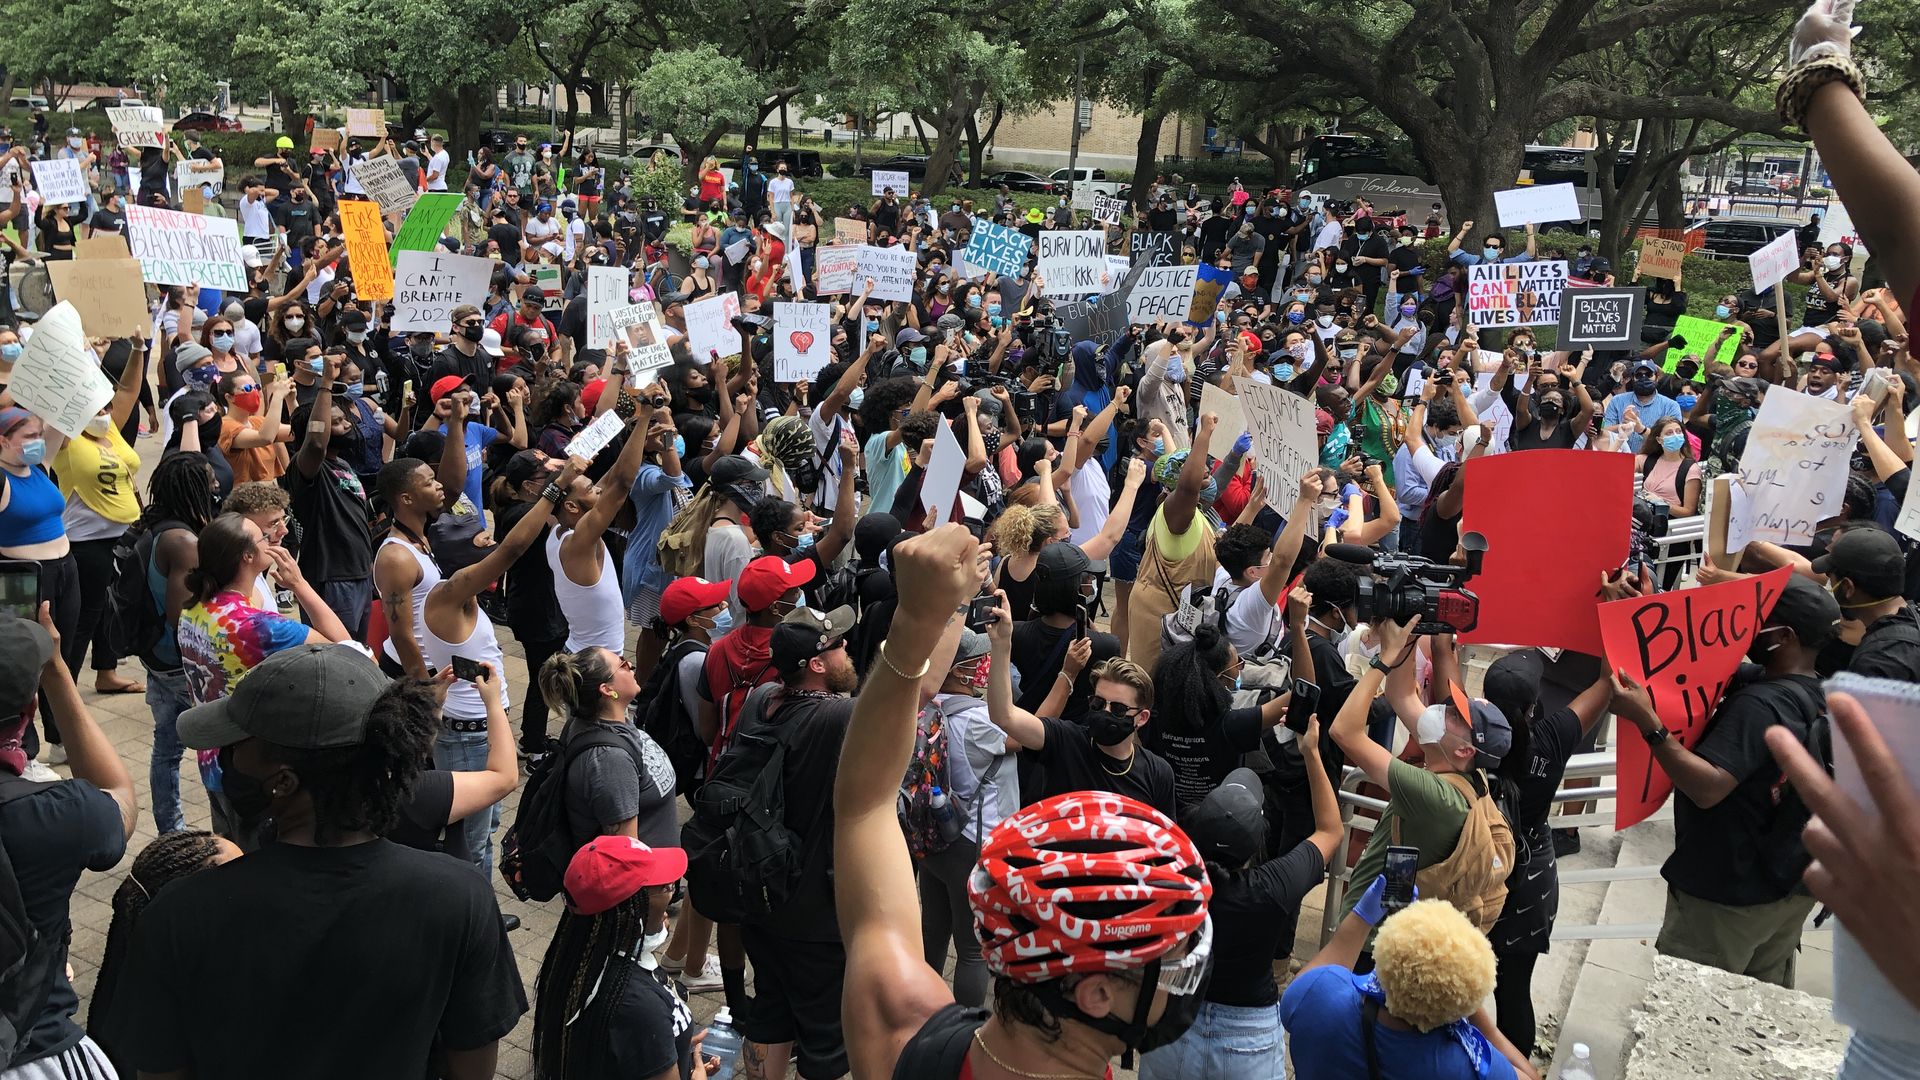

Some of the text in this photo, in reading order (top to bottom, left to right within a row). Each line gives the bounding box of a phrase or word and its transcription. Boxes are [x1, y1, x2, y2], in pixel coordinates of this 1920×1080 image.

[110, 107, 158, 123] JUSTICE
[119, 130, 155, 146] GEORGE
[1350, 177, 1422, 195] Vonlane
[1094, 195, 1122, 211] GEORGE
[1093, 207, 1120, 223] FLOYD
[355, 229, 372, 244] THE
[974, 219, 1033, 251] BLACK
[1131, 232, 1174, 253] BLACK
[349, 240, 386, 264] CORRUPT
[969, 233, 1024, 265] LIVES
[1041, 235, 1105, 260] BURN DOWN
[1645, 238, 1685, 253] WE STAND
[1655, 249, 1665, 257] IN
[430, 257, 445, 272] I
[861, 249, 869, 259] IF
[900, 255, 914, 264] NOT
[963, 247, 1021, 280] MATTER
[1642, 253, 1681, 271] SOLIDARITY
[354, 263, 392, 283] SYSTEM
[901, 268, 914, 276] NOT
[1046, 264, 1100, 288] AMERIKKKA
[1139, 269, 1195, 288] JUSTICE
[1505, 263, 1562, 279] LIVES
[405, 273, 457, 288] CAN'T
[881, 276, 913, 286] ATTENTION
[1470, 278, 1567, 296] CANT MATTER
[400, 290, 463, 305] BREATHE
[594, 275, 600, 304] I
[544, 299, 562, 310] LM
[783, 303, 824, 316] BLACK
[1138, 295, 1190, 316] PEACE
[1470, 291, 1562, 311] UNTIL BLAC
[1580, 300, 1619, 313] BLACK
[614, 303, 653, 319] JUSTICE FOR
[1471, 308, 1560, 326] LIVES MATTE
[1587, 312, 1621, 324] LIVES
[614, 312, 657, 330] GEORGE FLOYD
[711, 322, 719, 337] 4
[778, 317, 829, 332] LIVES
[1581, 323, 1617, 334] MATTER
[628, 343, 667, 360] BLACK LIVES
[11, 337, 63, 401] BLACK
[57, 392, 93, 432] JUSTICE
[1241, 383, 1302, 428] HIS NAME
[1249, 407, 1284, 441] WAS
[1259, 431, 1292, 477] GEORGE
[1631, 580, 1775, 681] Black
[1103, 923, 1152, 940] Supreme
